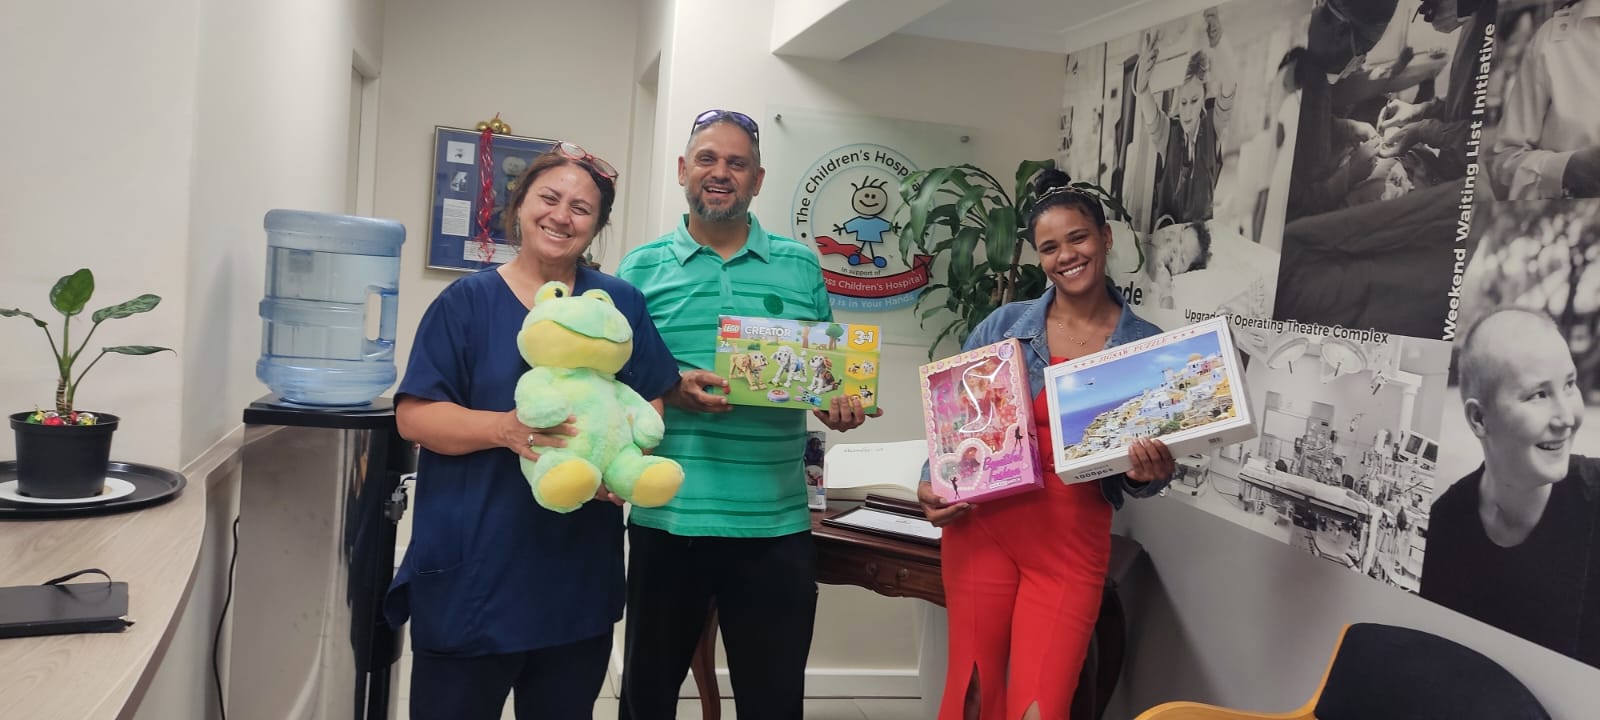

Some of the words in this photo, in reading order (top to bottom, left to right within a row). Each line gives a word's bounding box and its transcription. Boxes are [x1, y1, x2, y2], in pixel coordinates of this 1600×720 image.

[1472, 23, 1495, 115] Initiative
[1466, 120, 1482, 157] List
[797, 198, 811, 226] The
[805, 150, 870, 193] Children's
[1456, 163, 1480, 242] Waiting
[838, 280, 883, 291] Children's
[886, 274, 923, 290] Hospital
[848, 269, 873, 277] support
[861, 300, 882, 308] Your
[885, 294, 914, 306] Hands
[1442, 249, 1466, 341] Weekend
[723, 323, 740, 333] LEGO
[744, 326, 792, 337] CREATOR
[1234, 314, 1284, 334] Operating
[1287, 320, 1330, 337] Theatre
[1333, 325, 1389, 345] Complex
[1099, 348, 1128, 362] JIGSAW
[1133, 337, 1168, 352] PUZZLE
[1075, 468, 1113, 480] 1000pcs
